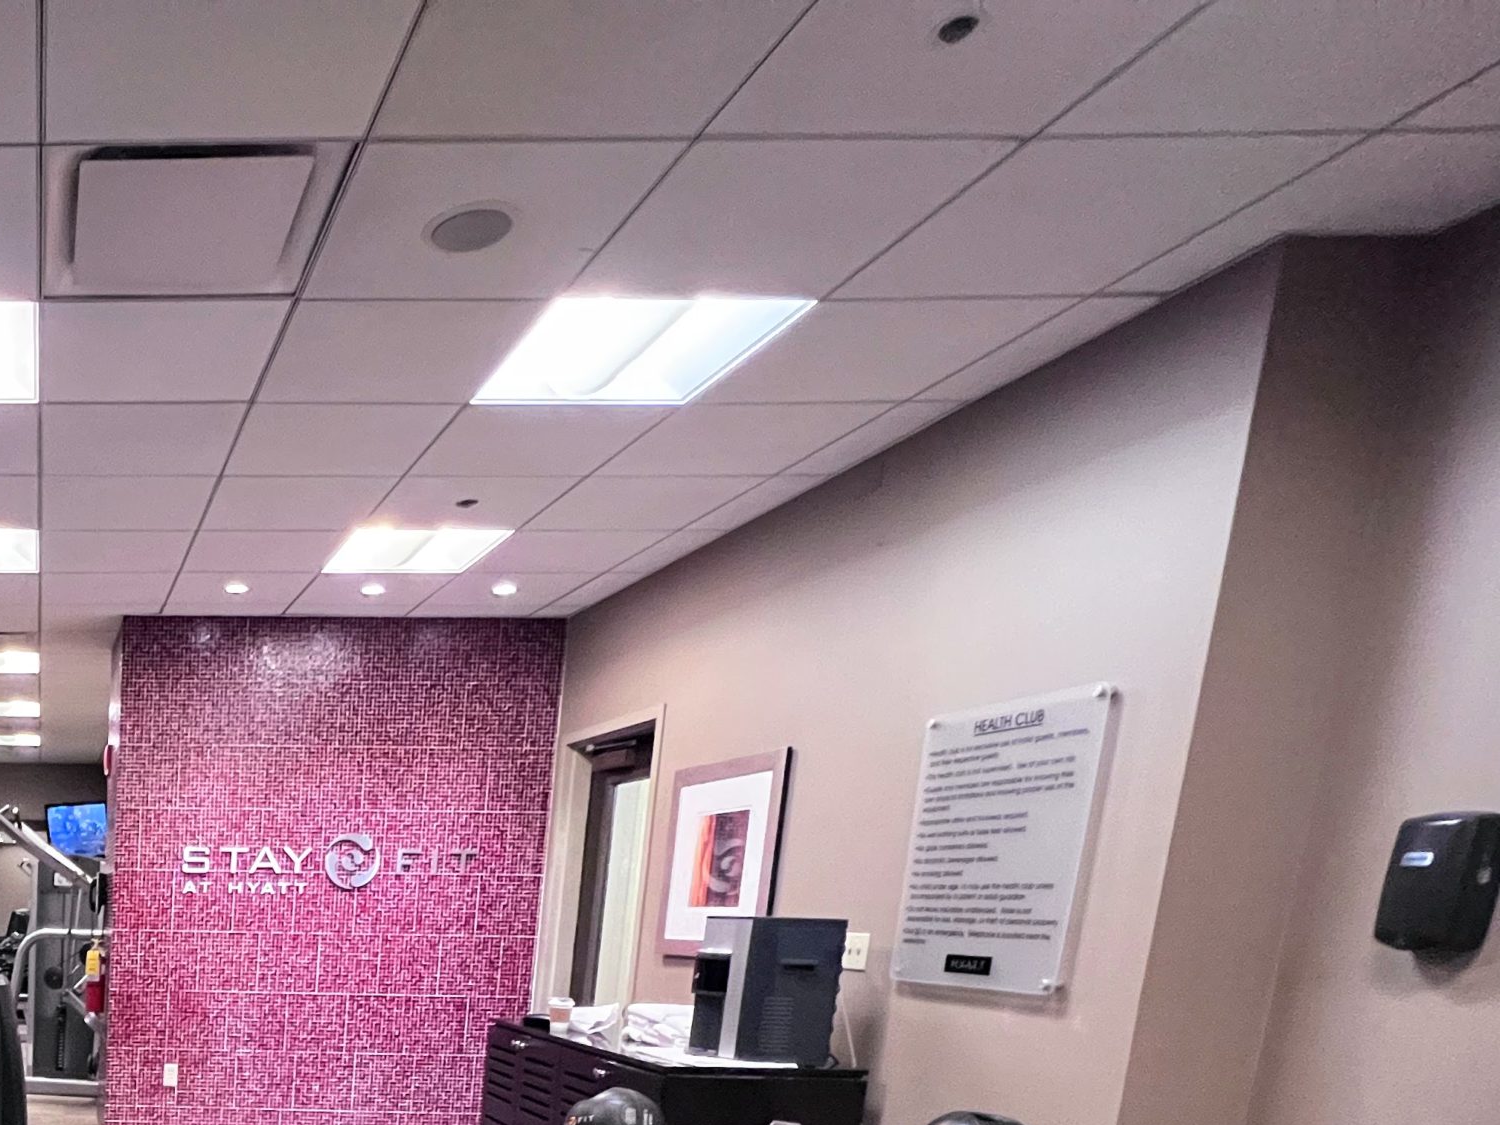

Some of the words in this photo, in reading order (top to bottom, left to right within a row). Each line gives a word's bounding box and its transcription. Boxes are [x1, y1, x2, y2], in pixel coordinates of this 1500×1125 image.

[974, 714, 1013, 733] HEALTH
[1015, 709, 1044, 726] CLUB
[182, 846, 313, 874] STAY
[396, 848, 480, 874] FIT
[182, 880, 212, 894] AT
[228, 880, 308, 895] HYATT
[578, 1114, 595, 1124] FIT
